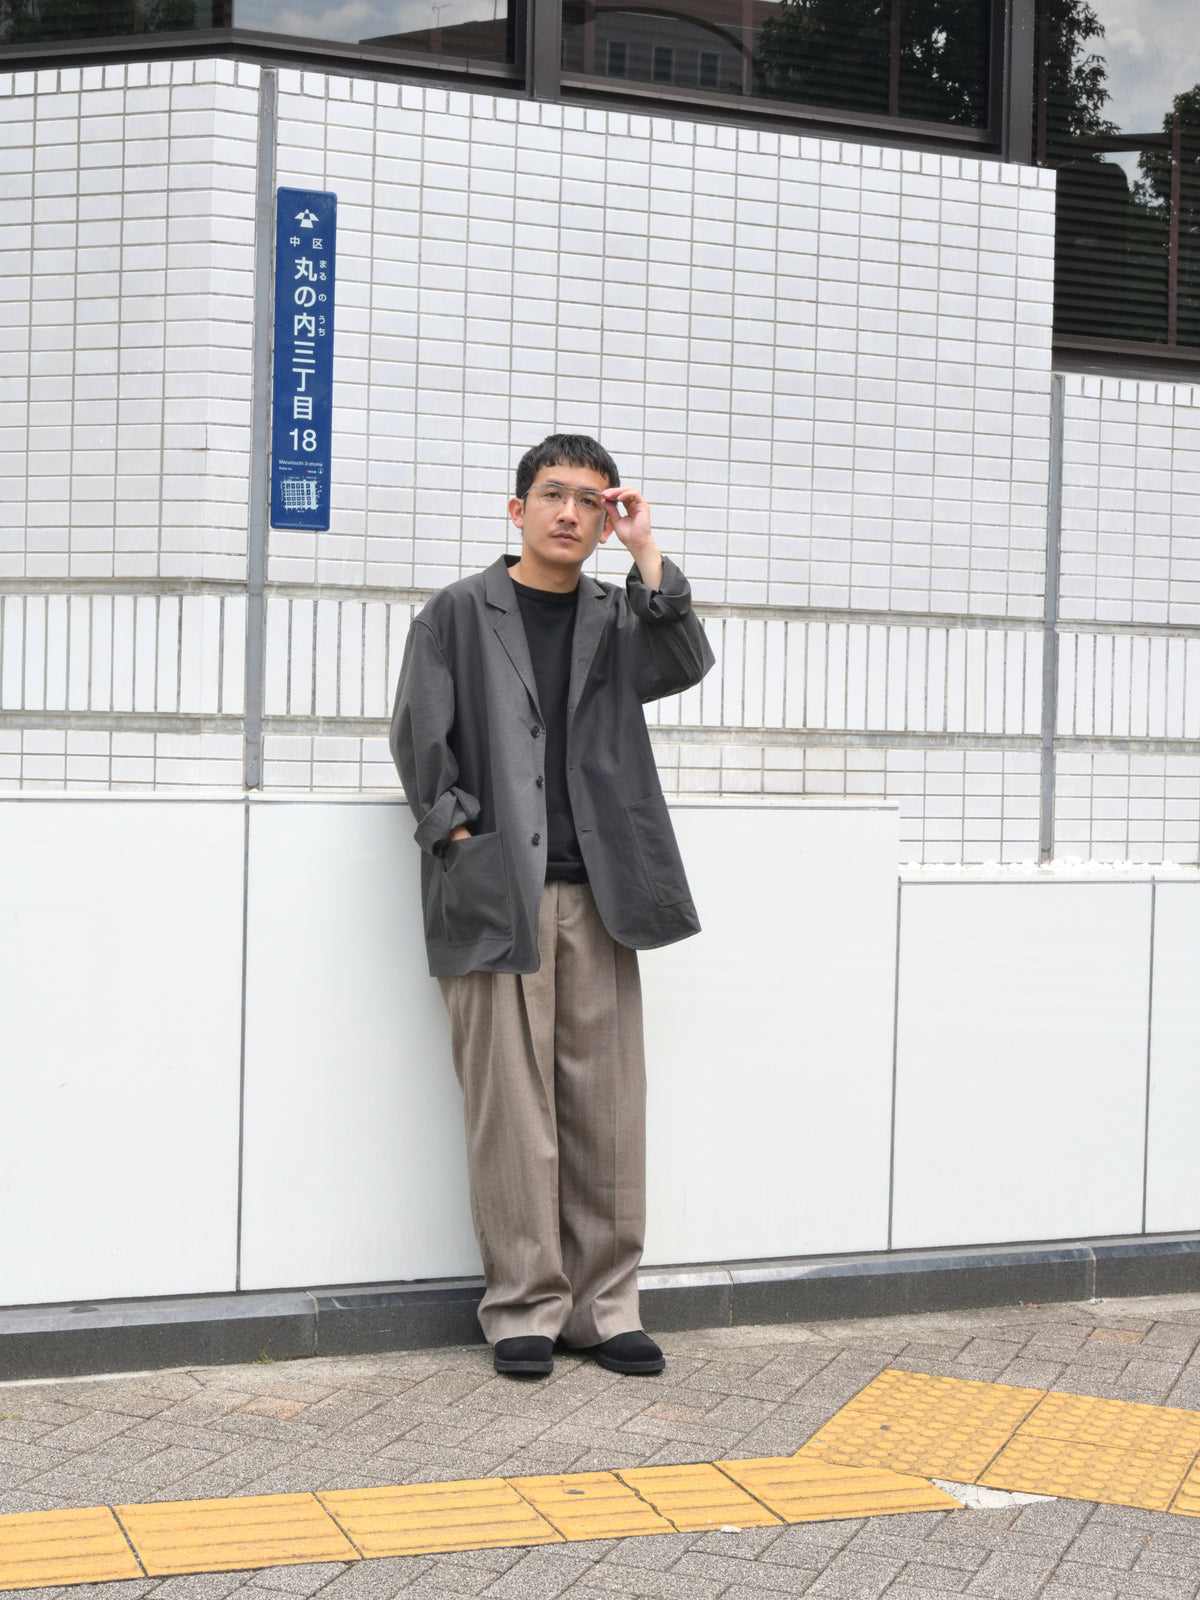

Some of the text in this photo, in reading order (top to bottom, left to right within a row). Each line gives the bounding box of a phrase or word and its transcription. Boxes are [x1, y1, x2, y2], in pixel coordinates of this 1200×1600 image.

[292, 256, 318, 421] 丸の内三丁目
[289, 428, 317, 452] 18
